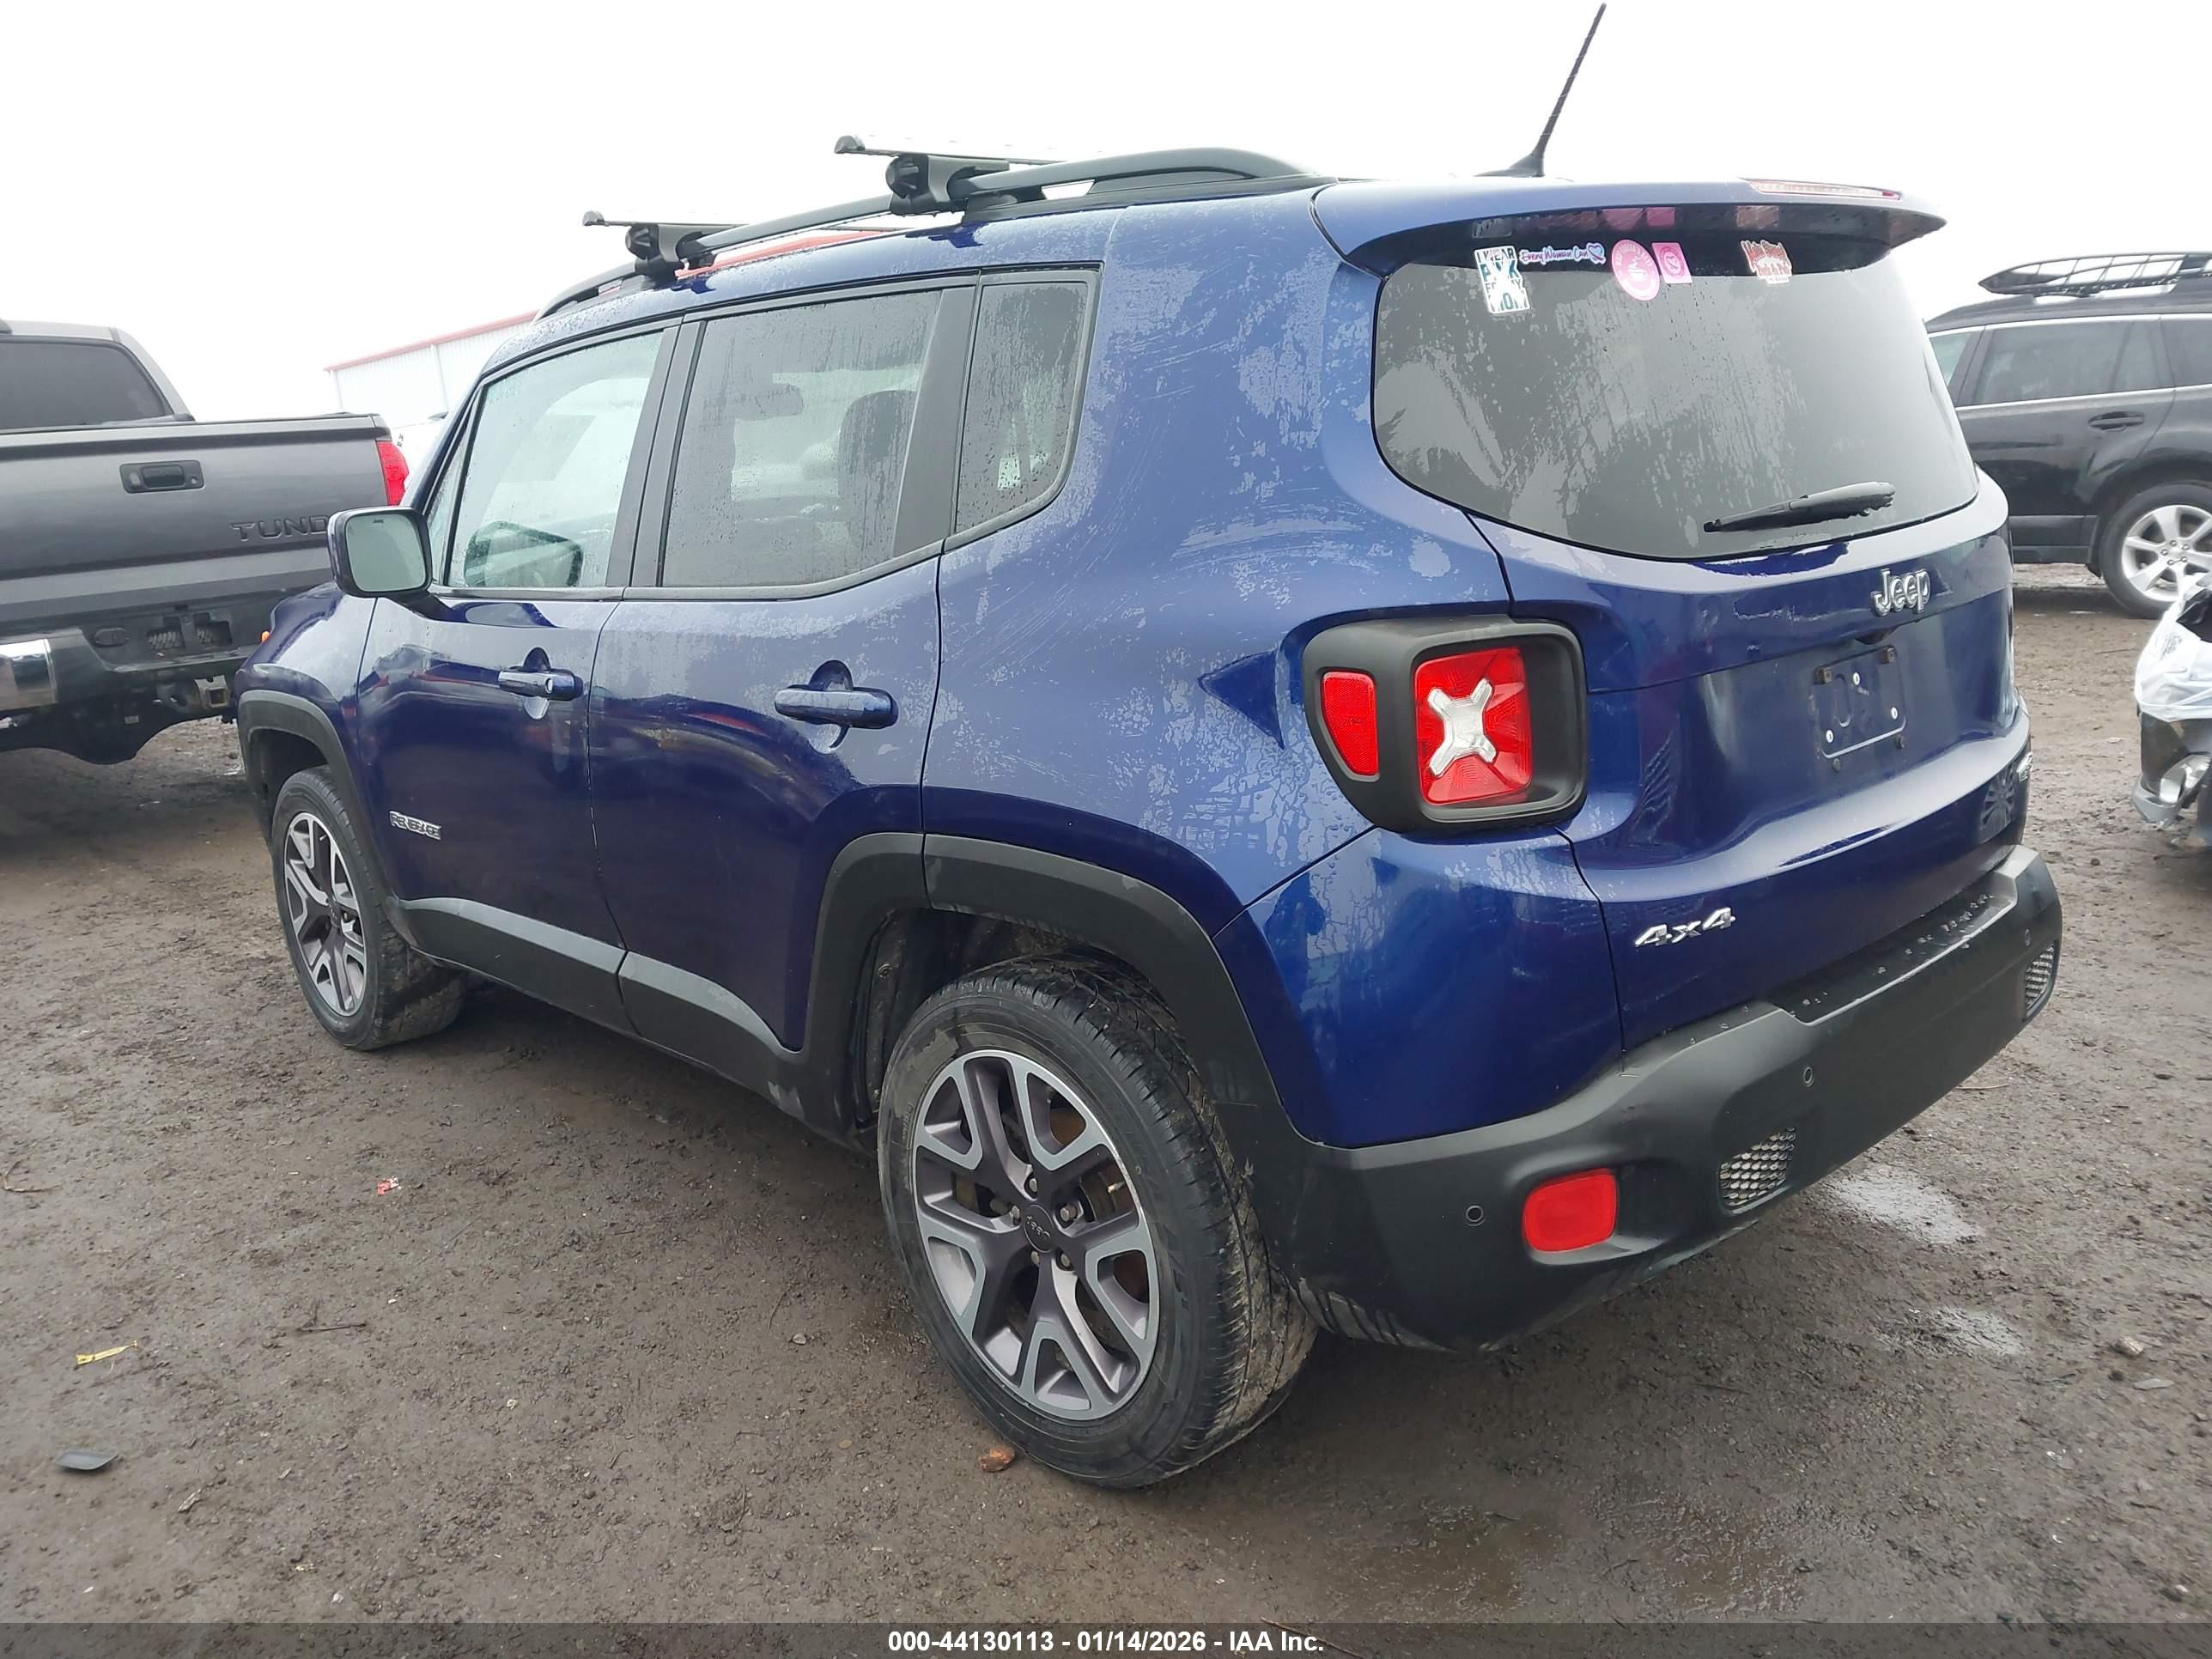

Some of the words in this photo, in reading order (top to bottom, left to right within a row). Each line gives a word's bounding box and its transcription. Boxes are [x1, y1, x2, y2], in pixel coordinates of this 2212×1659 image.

[1476, 252, 1481, 263] I
[1522, 251, 1544, 264] Every
[1543, 246, 1571, 259] Woman
[1573, 246, 1589, 260] Can
[1480, 259, 1520, 283] PK
[1870, 568, 1931, 617] Jeep
[388, 810, 442, 841] RENEGADE
[1634, 906, 1736, 948] 4x4
